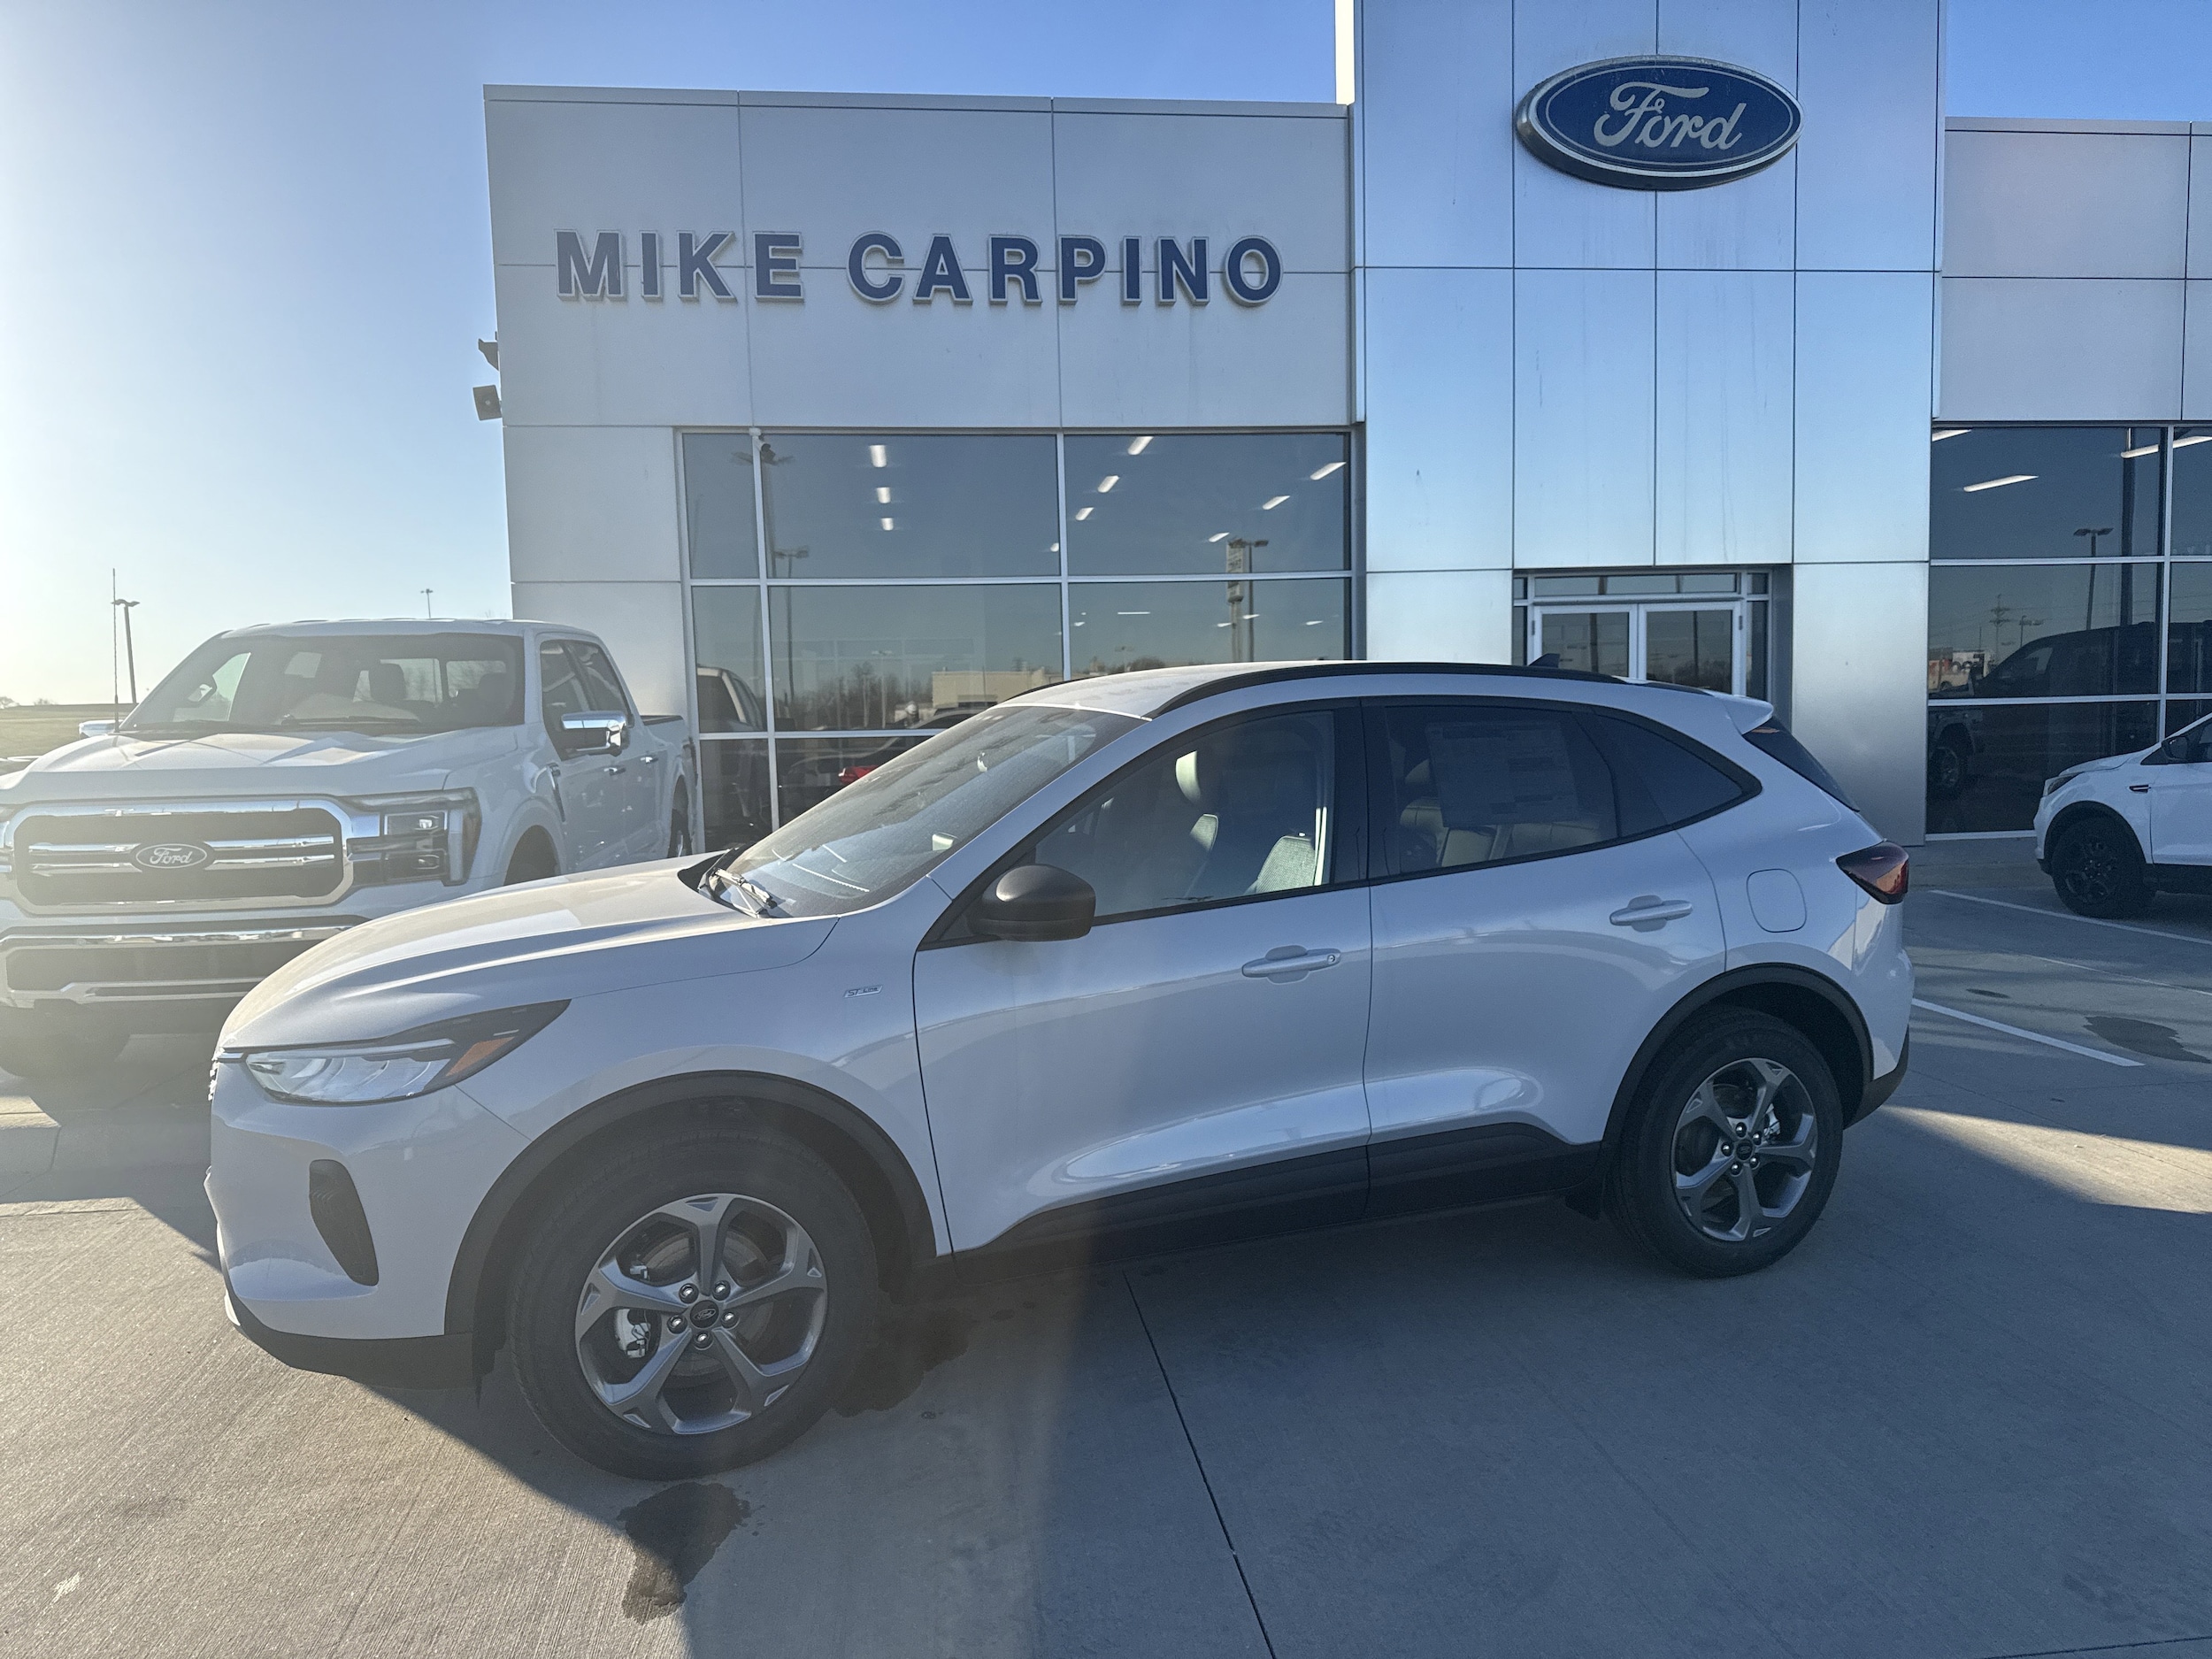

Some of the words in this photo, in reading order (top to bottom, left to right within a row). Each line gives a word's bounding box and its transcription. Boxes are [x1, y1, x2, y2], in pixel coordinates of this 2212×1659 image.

[1594, 81, 1747, 150] Ford
[555, 229, 804, 303] MIKE
[847, 231, 1284, 306] CARPINO
[150, 847, 193, 864] Ford
